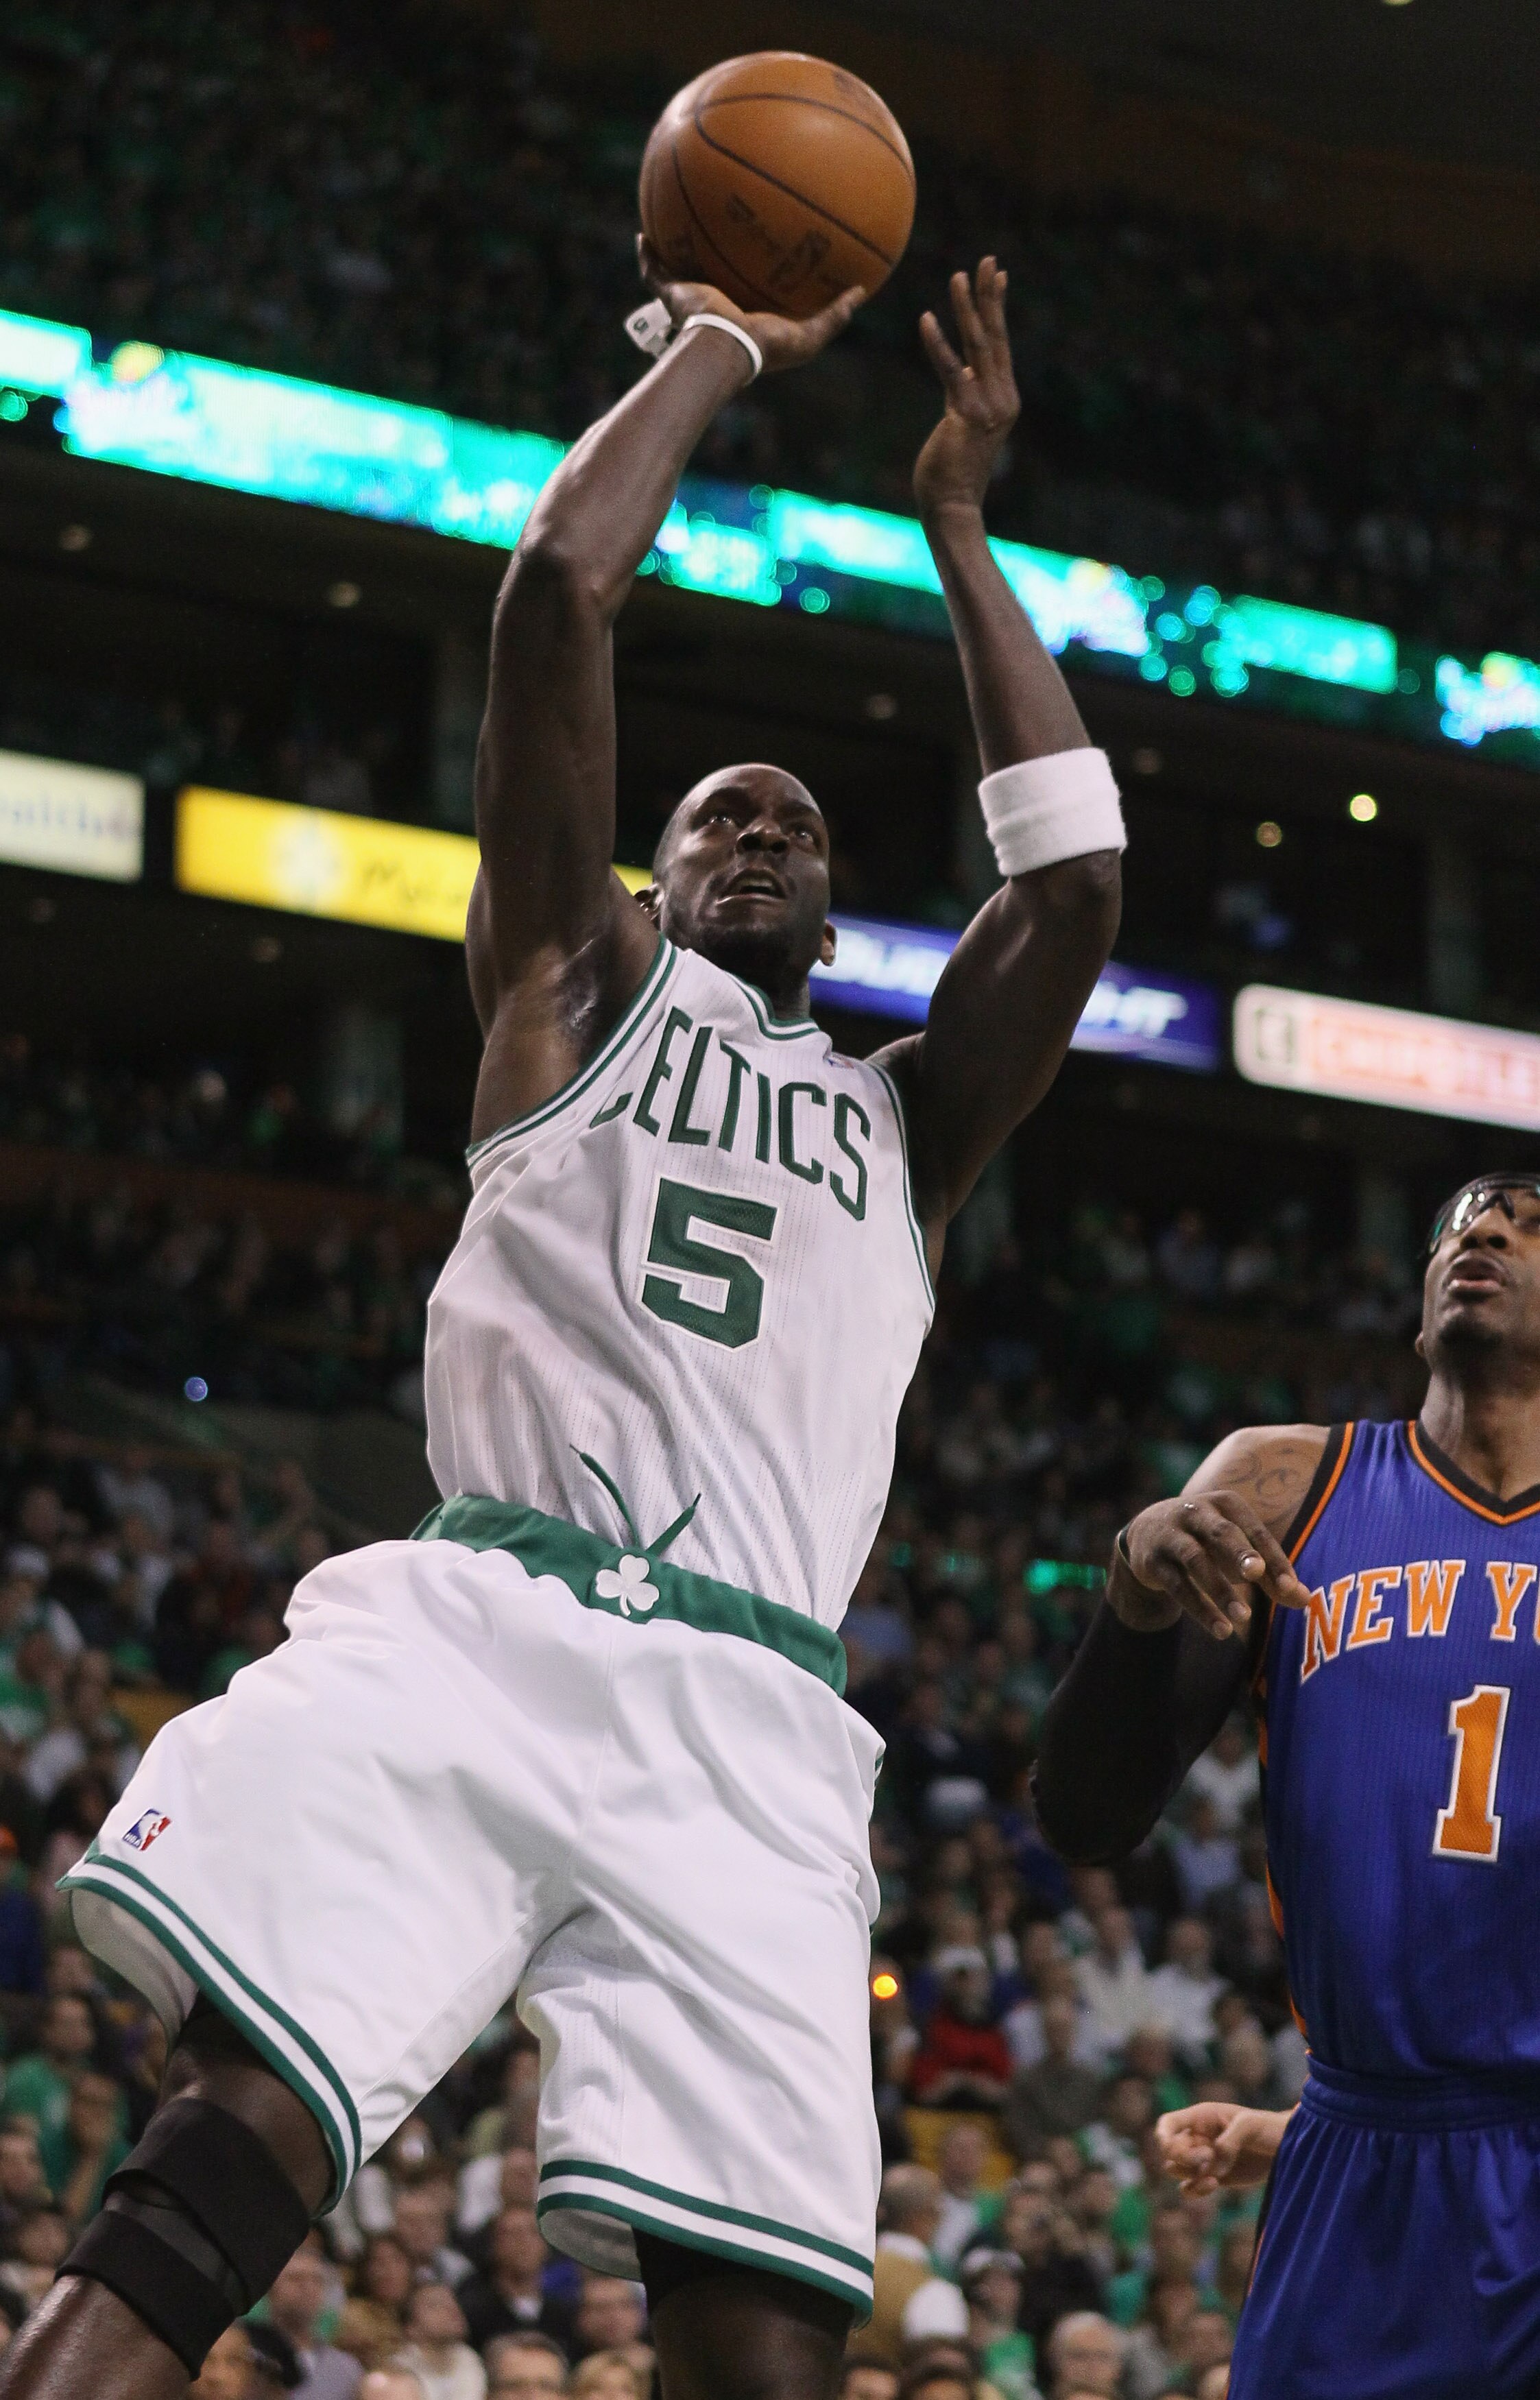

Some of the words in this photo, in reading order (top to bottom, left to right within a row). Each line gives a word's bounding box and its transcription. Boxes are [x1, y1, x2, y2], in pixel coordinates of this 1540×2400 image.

[639, 1176, 780, 1351] 5
[1300, 1559, 1466, 1685] NEW
[1485, 1561, 1540, 1646] Y
[123, 1832, 142, 1848] NBA
[1432, 1684, 1511, 1862] 1
